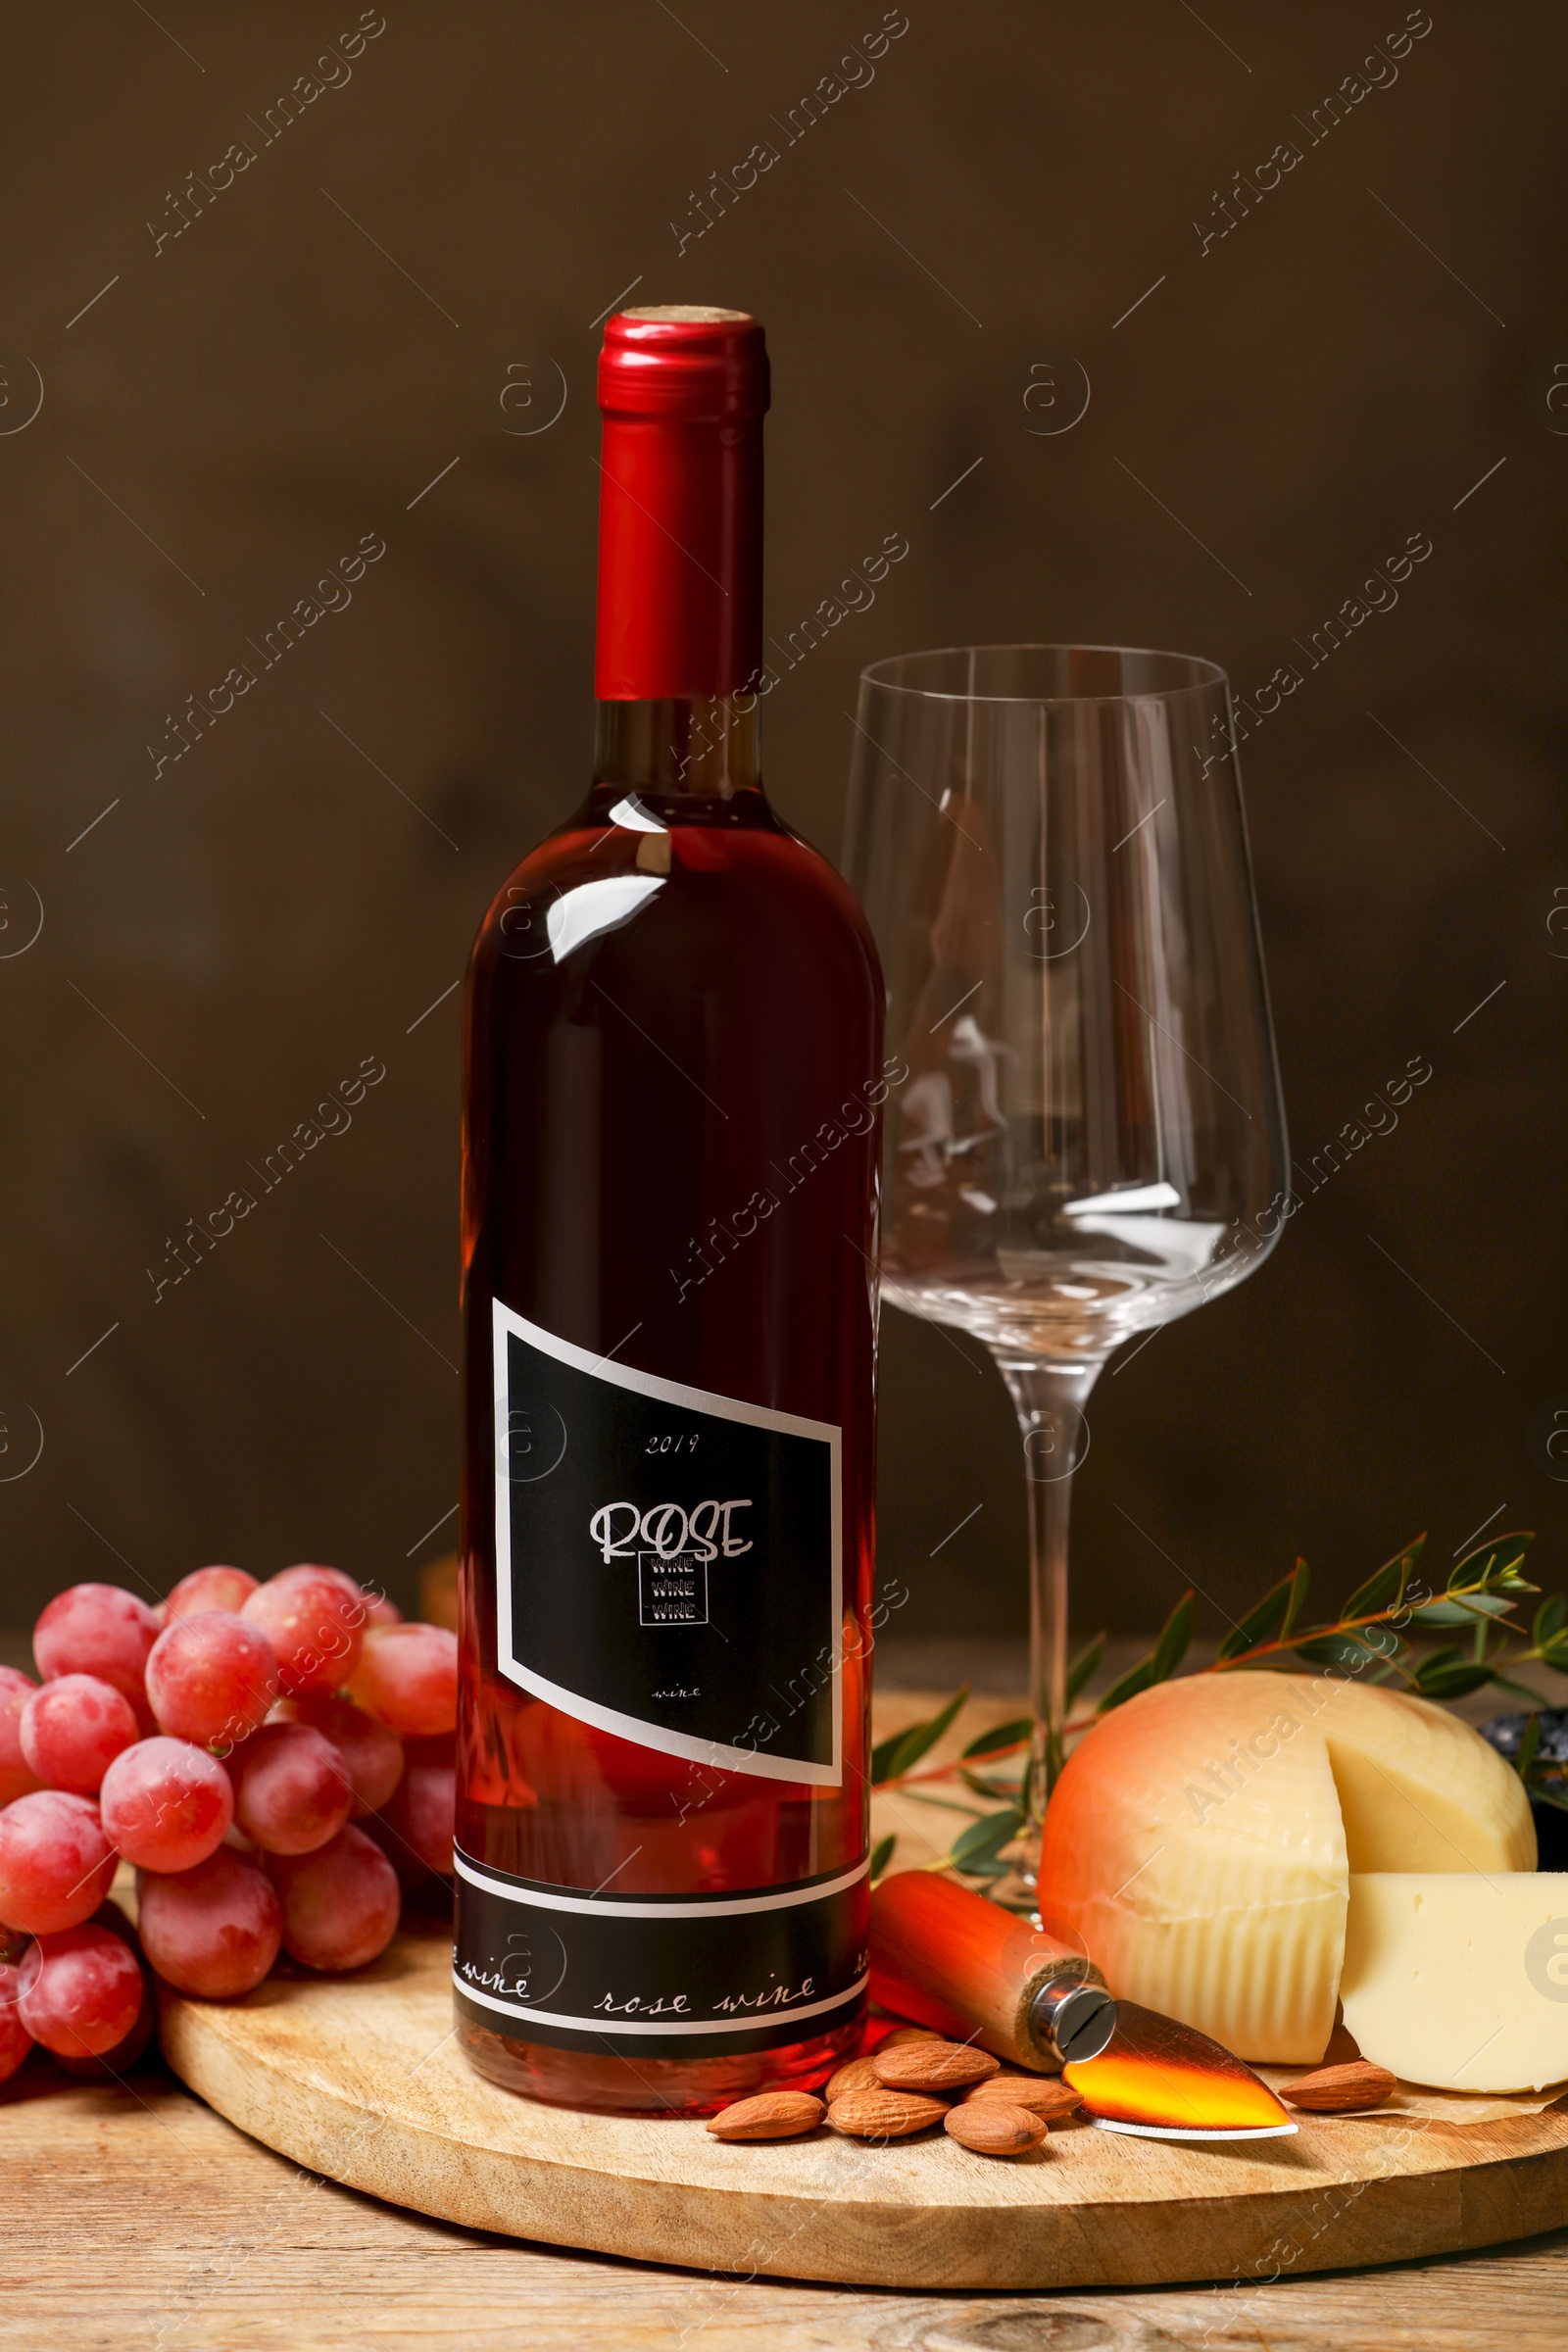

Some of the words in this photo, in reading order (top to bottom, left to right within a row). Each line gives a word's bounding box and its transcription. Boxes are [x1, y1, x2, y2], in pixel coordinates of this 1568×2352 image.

[645, 1434, 700, 1454] 2019
[589, 1498, 754, 1565] ROSE
[651, 1556, 695, 1574] WINE
[652, 1579, 695, 1597] WINE
[652, 1602, 696, 1620] WINE
[652, 1683, 702, 1698] wine
[462, 1956, 530, 1998] wine
[593, 1992, 691, 2015] rose
[712, 1973, 815, 2012] wine
